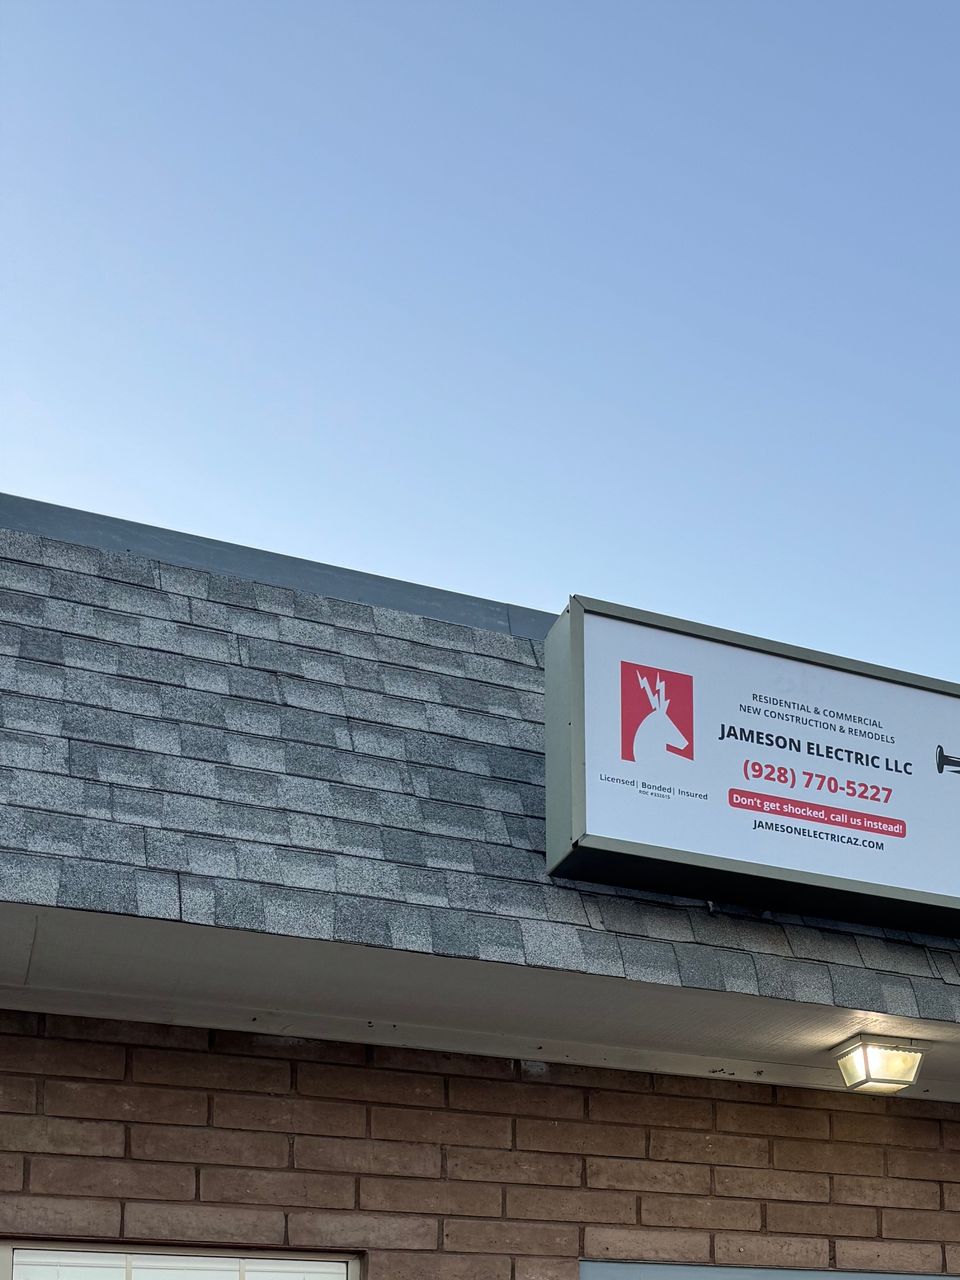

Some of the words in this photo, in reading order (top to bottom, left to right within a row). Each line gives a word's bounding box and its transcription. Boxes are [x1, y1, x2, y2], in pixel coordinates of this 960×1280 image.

[739, 704, 761, 715] NEW
[764, 709, 836, 732] CONSTRUCTION
[839, 725, 846, 734] &
[848, 728, 895, 744] REMODELS
[752, 694, 811, 713] RESIDENTIAL
[814, 706, 820, 715] &
[823, 709, 883, 728] COMMERCIAL
[718, 724, 801, 752] JAMESON
[807, 742, 880, 769] ELECTRIC
[885, 757, 913, 775] LLC
[678, 789, 708, 800] Insured
[743, 760, 796, 788] (928)
[802, 771, 892, 804] 770-5227
[733, 794, 761, 808] Don't
[763, 800, 781, 811] get
[783, 802, 828, 821] shocked,
[830, 813, 847, 823] call
[850, 817, 861, 826] us
[864, 818, 902, 834] instead!
[753, 819, 884, 850] JAMESONELECTRICAZ.COM
